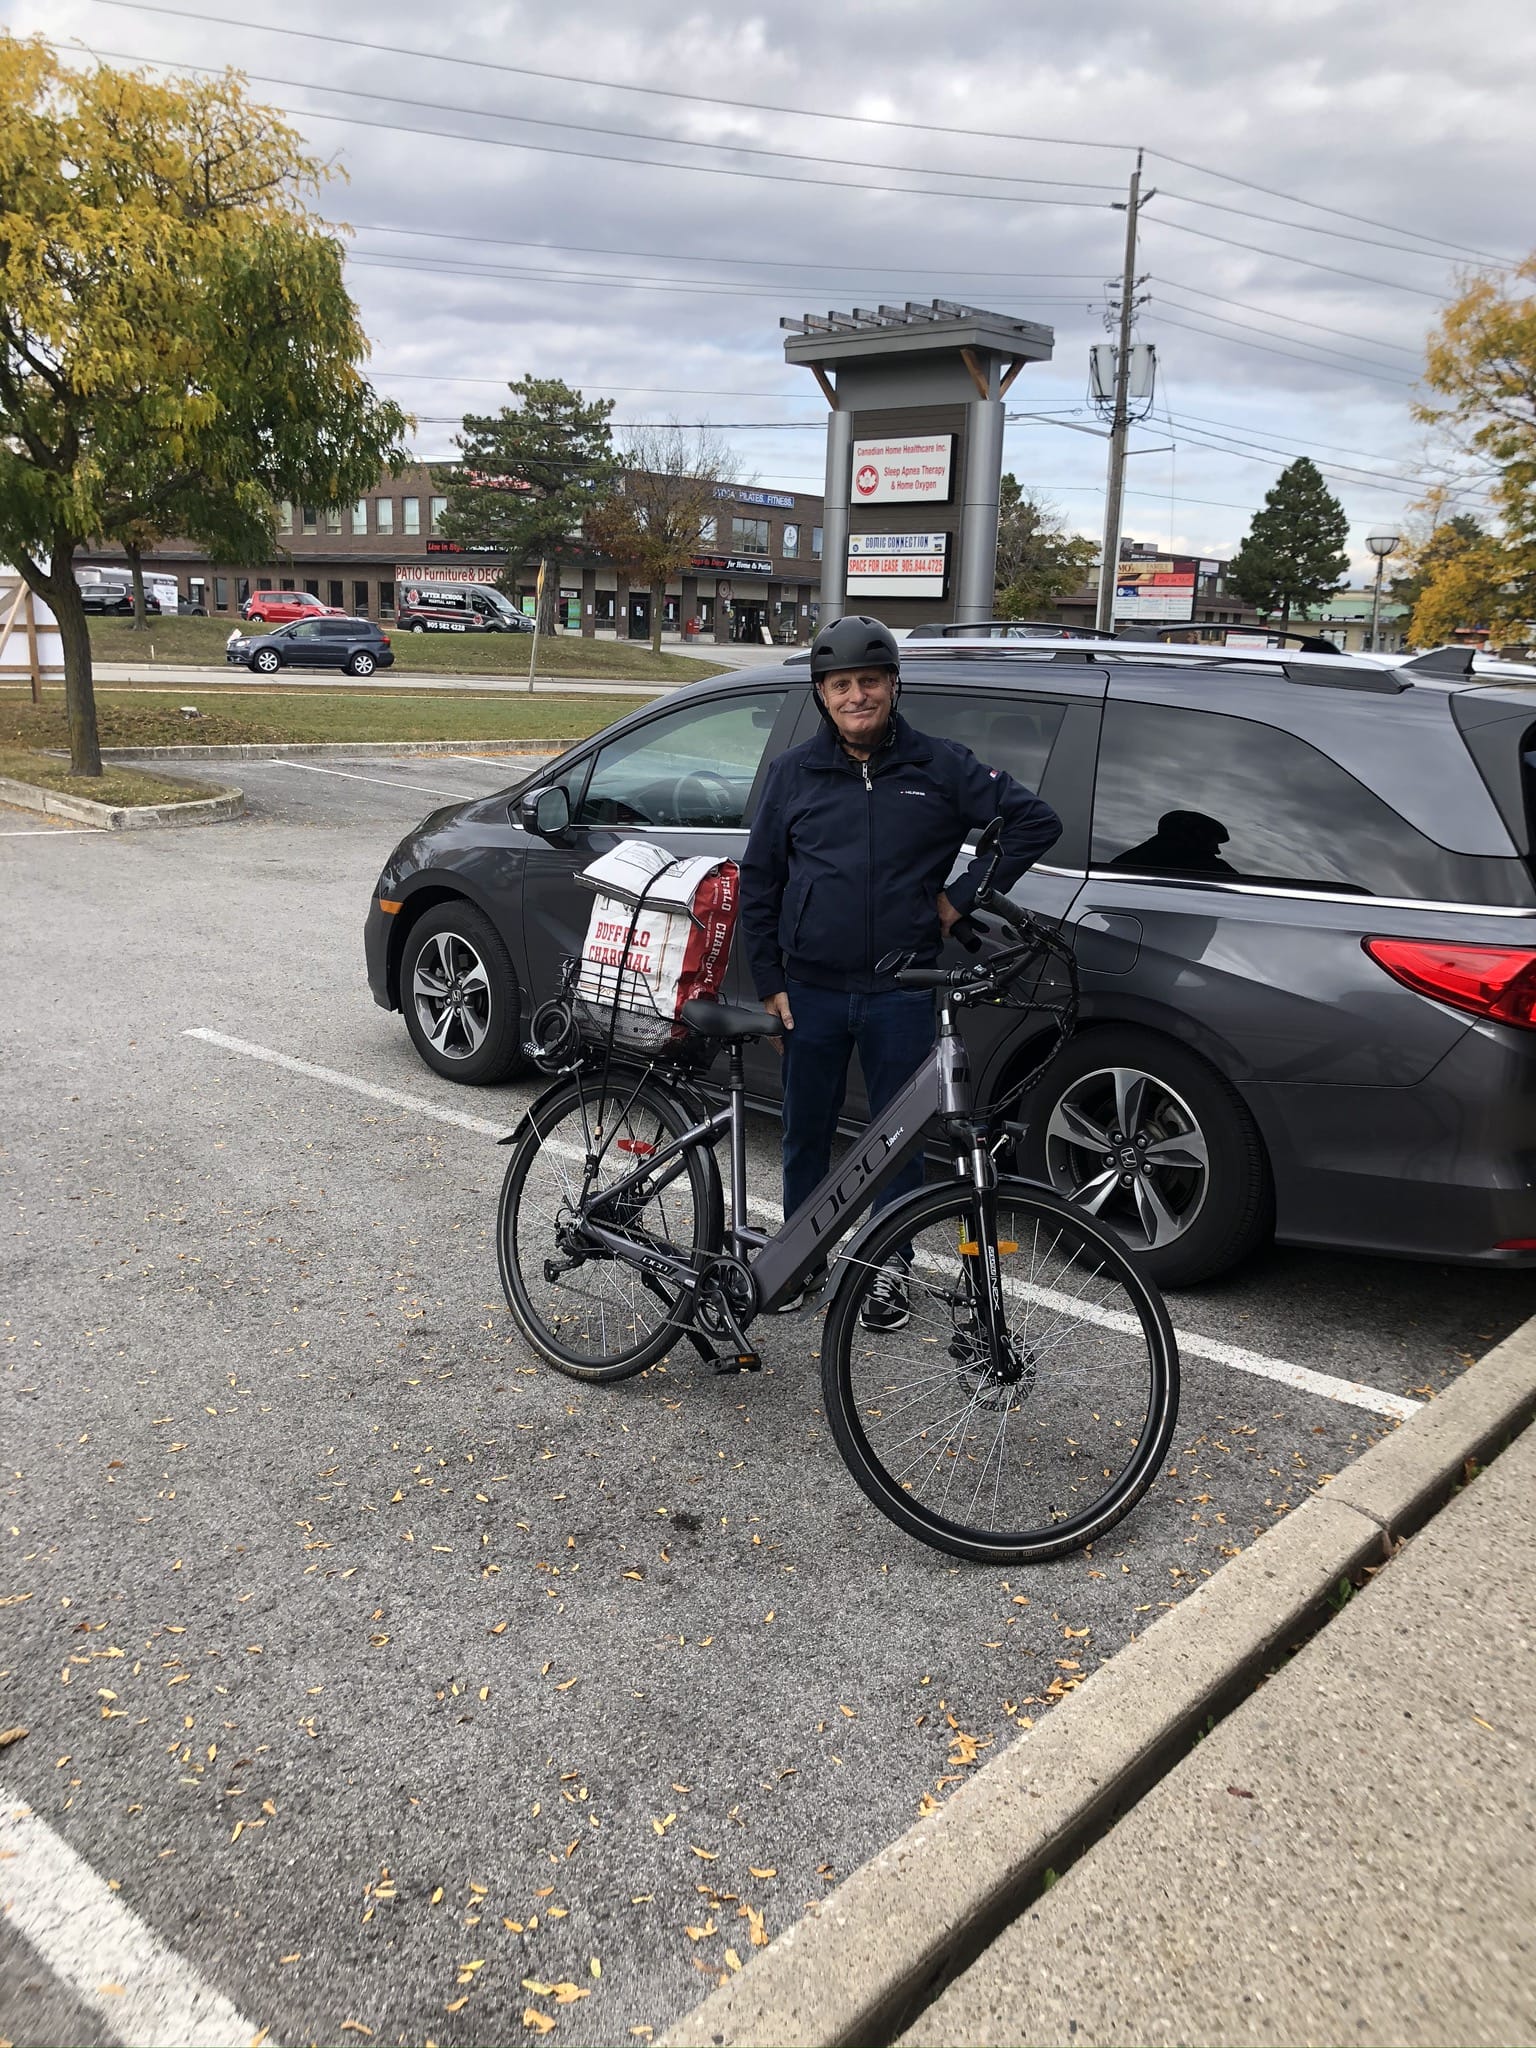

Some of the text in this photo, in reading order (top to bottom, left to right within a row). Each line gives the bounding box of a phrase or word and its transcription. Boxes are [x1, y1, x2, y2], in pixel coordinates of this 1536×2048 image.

[857, 447, 883, 456] Canadian
[885, 446, 901, 455] Home
[903, 444, 934, 454] Healthcare
[884, 465, 945, 478] Sleep Apnea Therapy
[897, 480, 913, 490] Home
[915, 480, 937, 491] Oxygen
[866, 536, 886, 548] COMIC
[888, 536, 929, 548] CONNECTION
[849, 559, 866, 573] SPACE
[868, 559, 879, 573] FOR
[881, 559, 898, 573] LEASE
[397, 566, 421, 580] PATIO
[424, 567, 467, 581] Furniture
[468, 567, 475, 581] &
